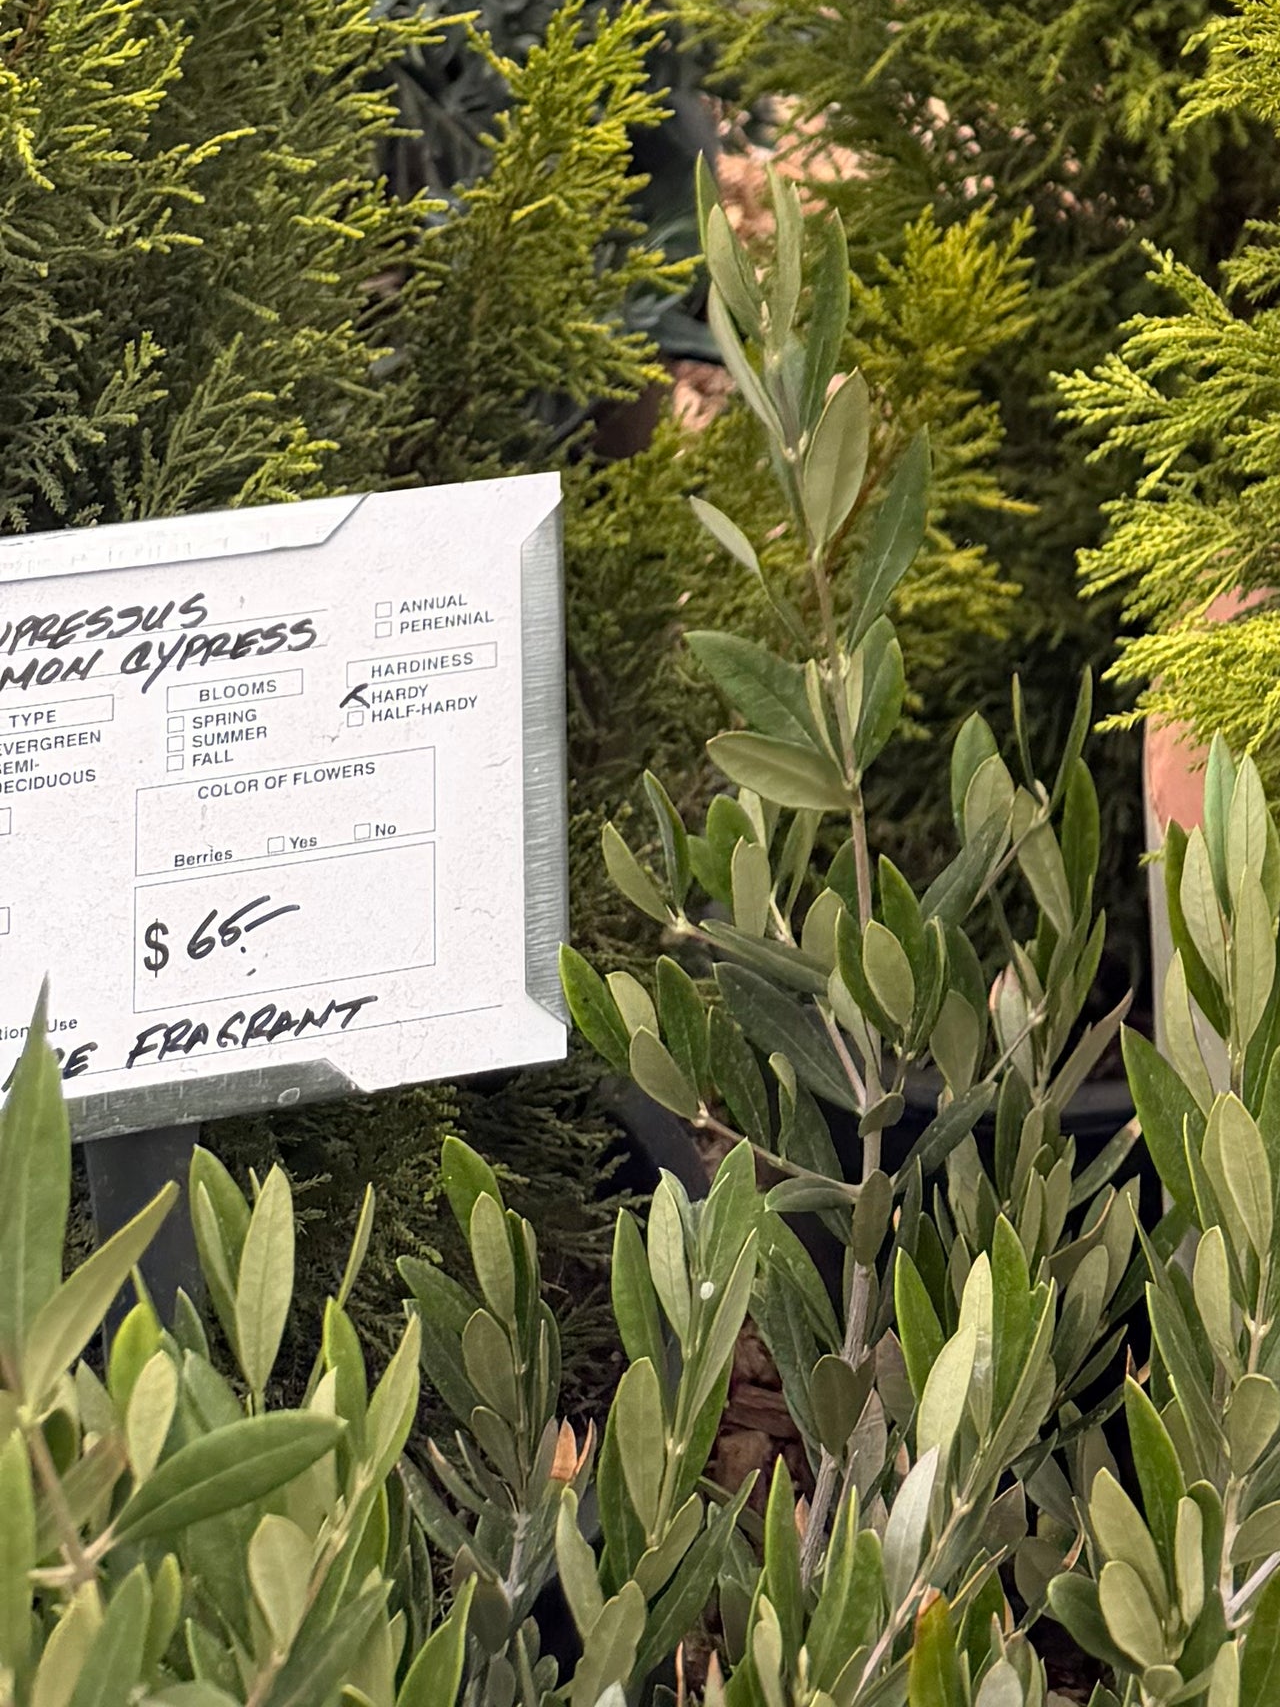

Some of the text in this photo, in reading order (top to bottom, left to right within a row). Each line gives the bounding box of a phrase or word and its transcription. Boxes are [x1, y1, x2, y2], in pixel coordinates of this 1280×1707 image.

[400, 594, 468, 615] ANNUAL
[400, 611, 495, 634] PERENNIAL
[120, 618, 318, 694] CYPRESS
[371, 652, 474, 679] HARDINESS
[199, 680, 277, 702] BLOOMS
[371, 684, 429, 705] HARDY
[9, 709, 57, 728] TYPE
[192, 709, 257, 730] SPRING
[371, 695, 478, 723] HALF-HARDY
[0, 729, 101, 757] VERGREEN
[192, 726, 268, 748] SUMMER
[192, 750, 234, 768] FALL
[197, 762, 376, 800] COLOR OF FLOWERS
[174, 823, 397, 868] Berries Yes No
[144, 918, 169, 978] $
[46, 1019, 78, 1034] Use
[127, 995, 378, 1069] FRAGRANT
